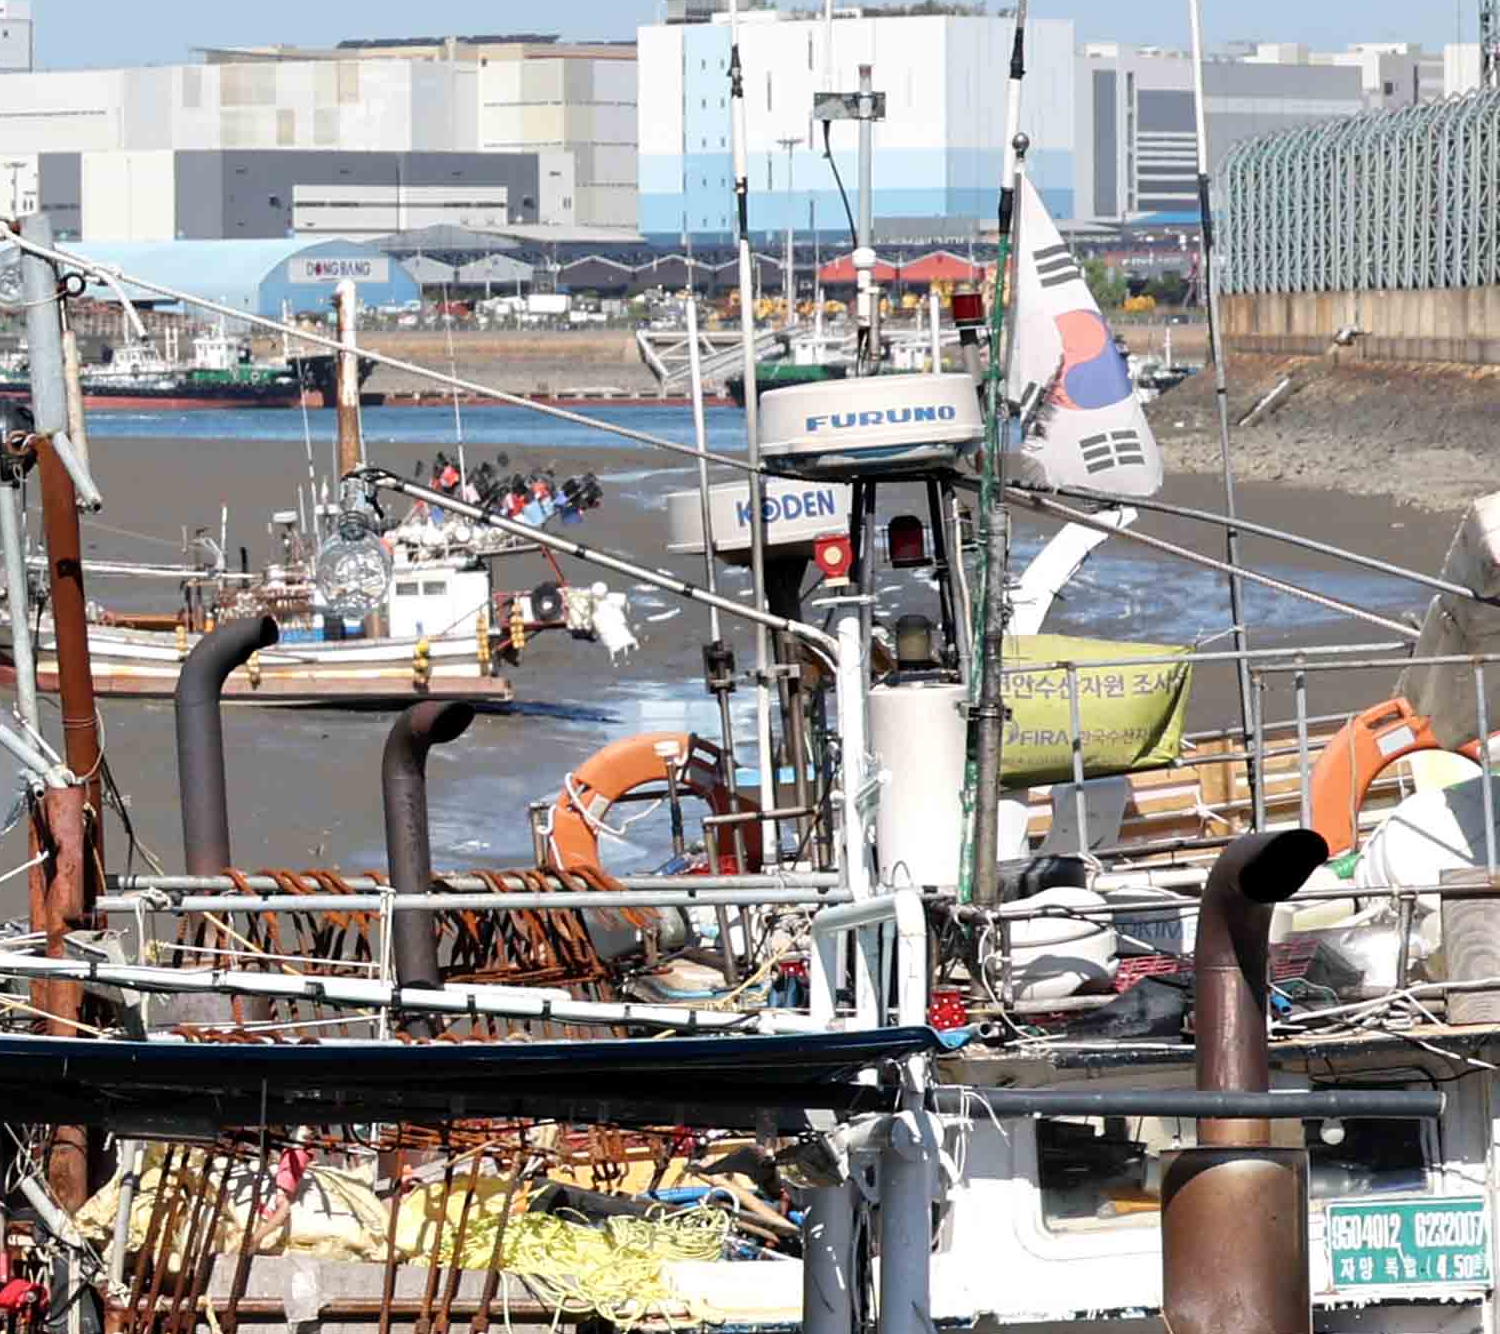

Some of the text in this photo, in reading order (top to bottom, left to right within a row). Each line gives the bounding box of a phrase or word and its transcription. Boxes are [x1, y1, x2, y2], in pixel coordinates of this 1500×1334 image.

[805, 404, 957, 432] FURUNO
[1020, 730, 1069, 746] FIRA
[1332, 1212, 1484, 1249] 9504012 6232007
[1339, 1256, 1374, 1281] 자망
